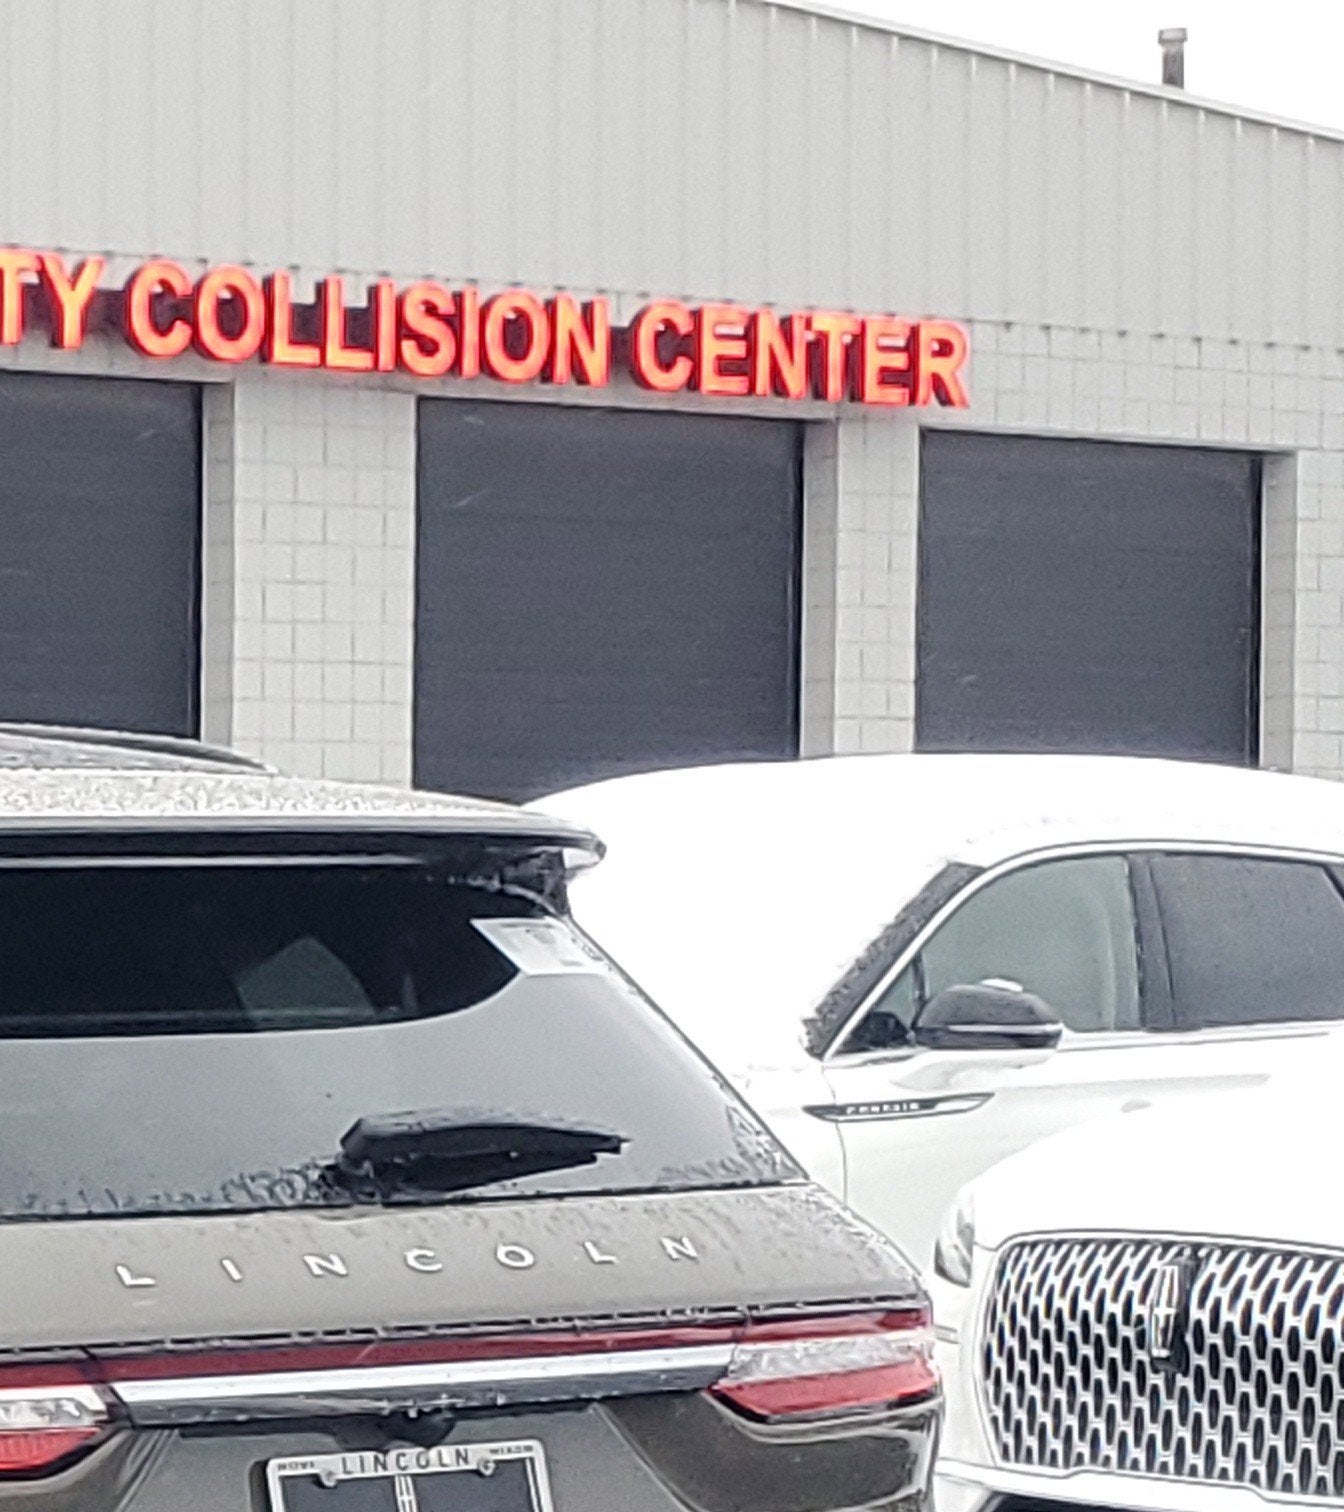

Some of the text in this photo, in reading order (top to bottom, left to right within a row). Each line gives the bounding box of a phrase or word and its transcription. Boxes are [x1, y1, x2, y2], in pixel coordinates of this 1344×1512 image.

[122, 257, 612, 388] COLLISION
[630, 298, 972, 409] CENTER
[115, 1235, 701, 1289] LINCOLN
[341, 1447, 471, 1475] LINCOLN
